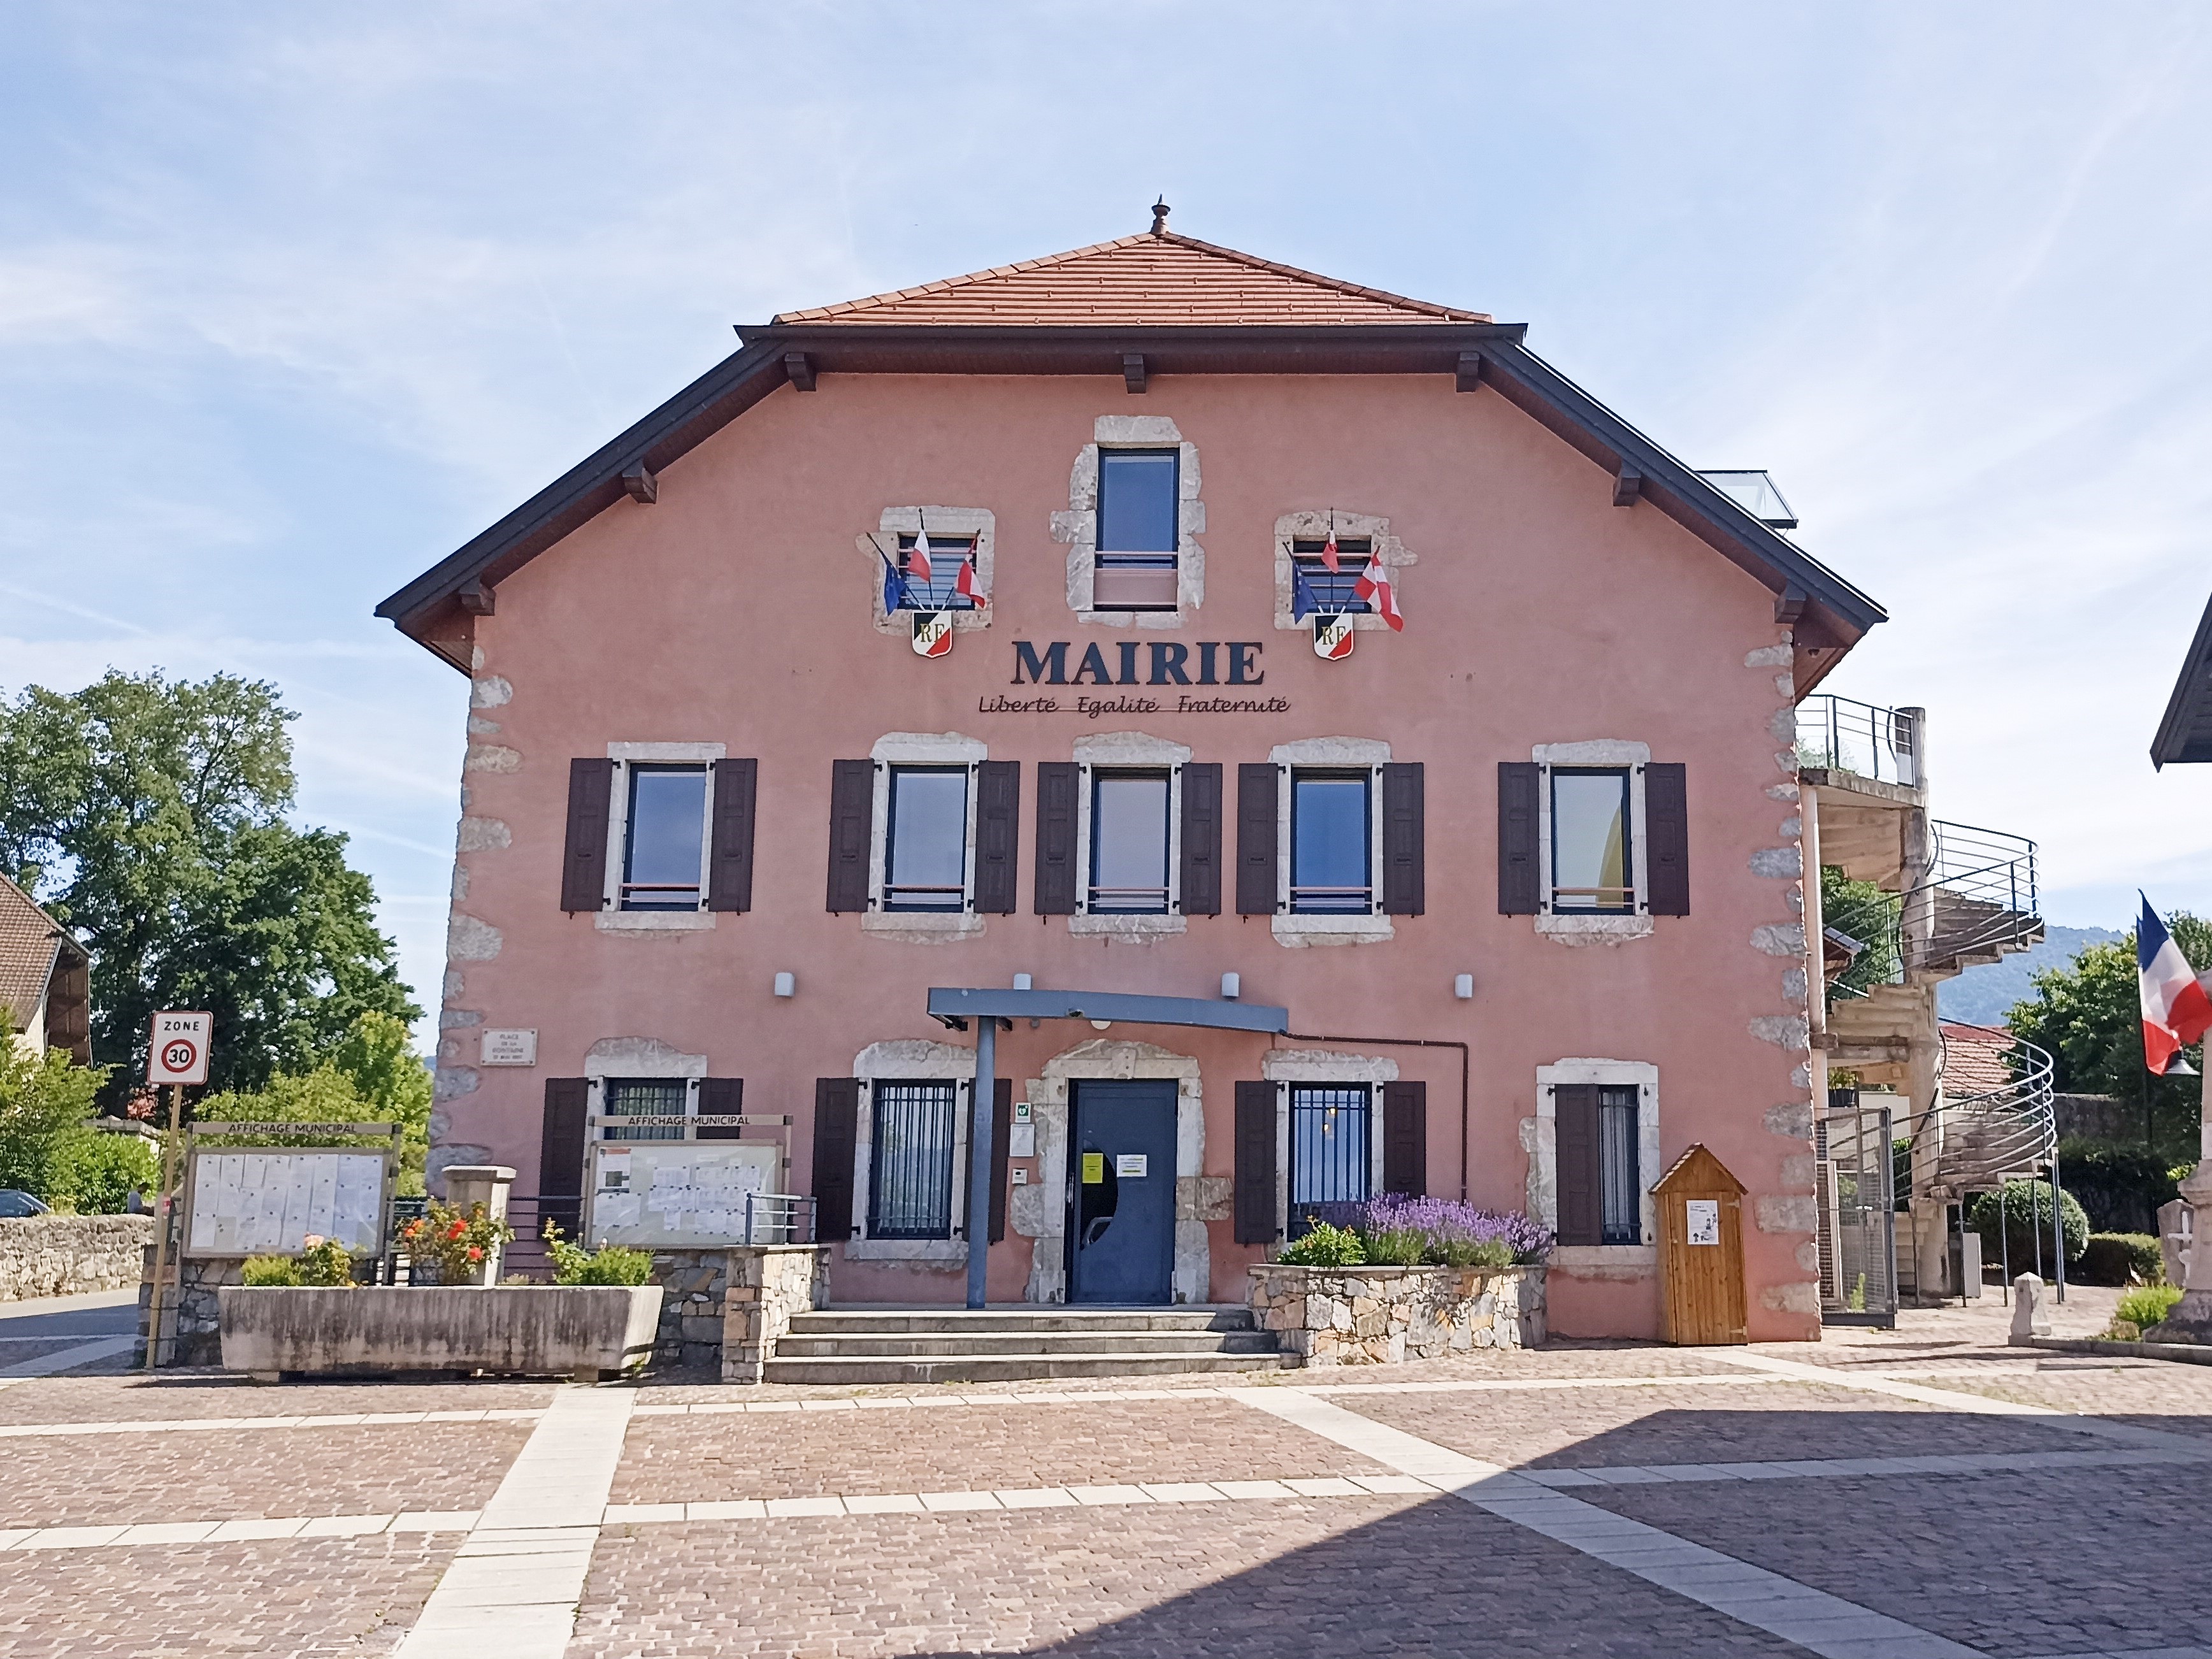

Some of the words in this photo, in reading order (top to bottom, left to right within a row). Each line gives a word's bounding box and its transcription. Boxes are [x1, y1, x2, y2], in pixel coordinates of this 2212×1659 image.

[920, 623, 945, 643] RF
[1321, 626, 1346, 645] RF
[1010, 641, 1265, 686] MAIRIE
[979, 695, 1060, 713] Liberté
[1077, 696, 1160, 719] Egalité
[1178, 695, 1292, 713] Fraternité
[164, 1021, 199, 1031] ZONE
[168, 1049, 190, 1063] 30
[228, 1123, 290, 1133] AFFICHAGE
[295, 1124, 357, 1133] MUNICIPAL
[628, 1116, 687, 1126] AFFICHAGE
[691, 1116, 750, 1125] MUNICIPAL
